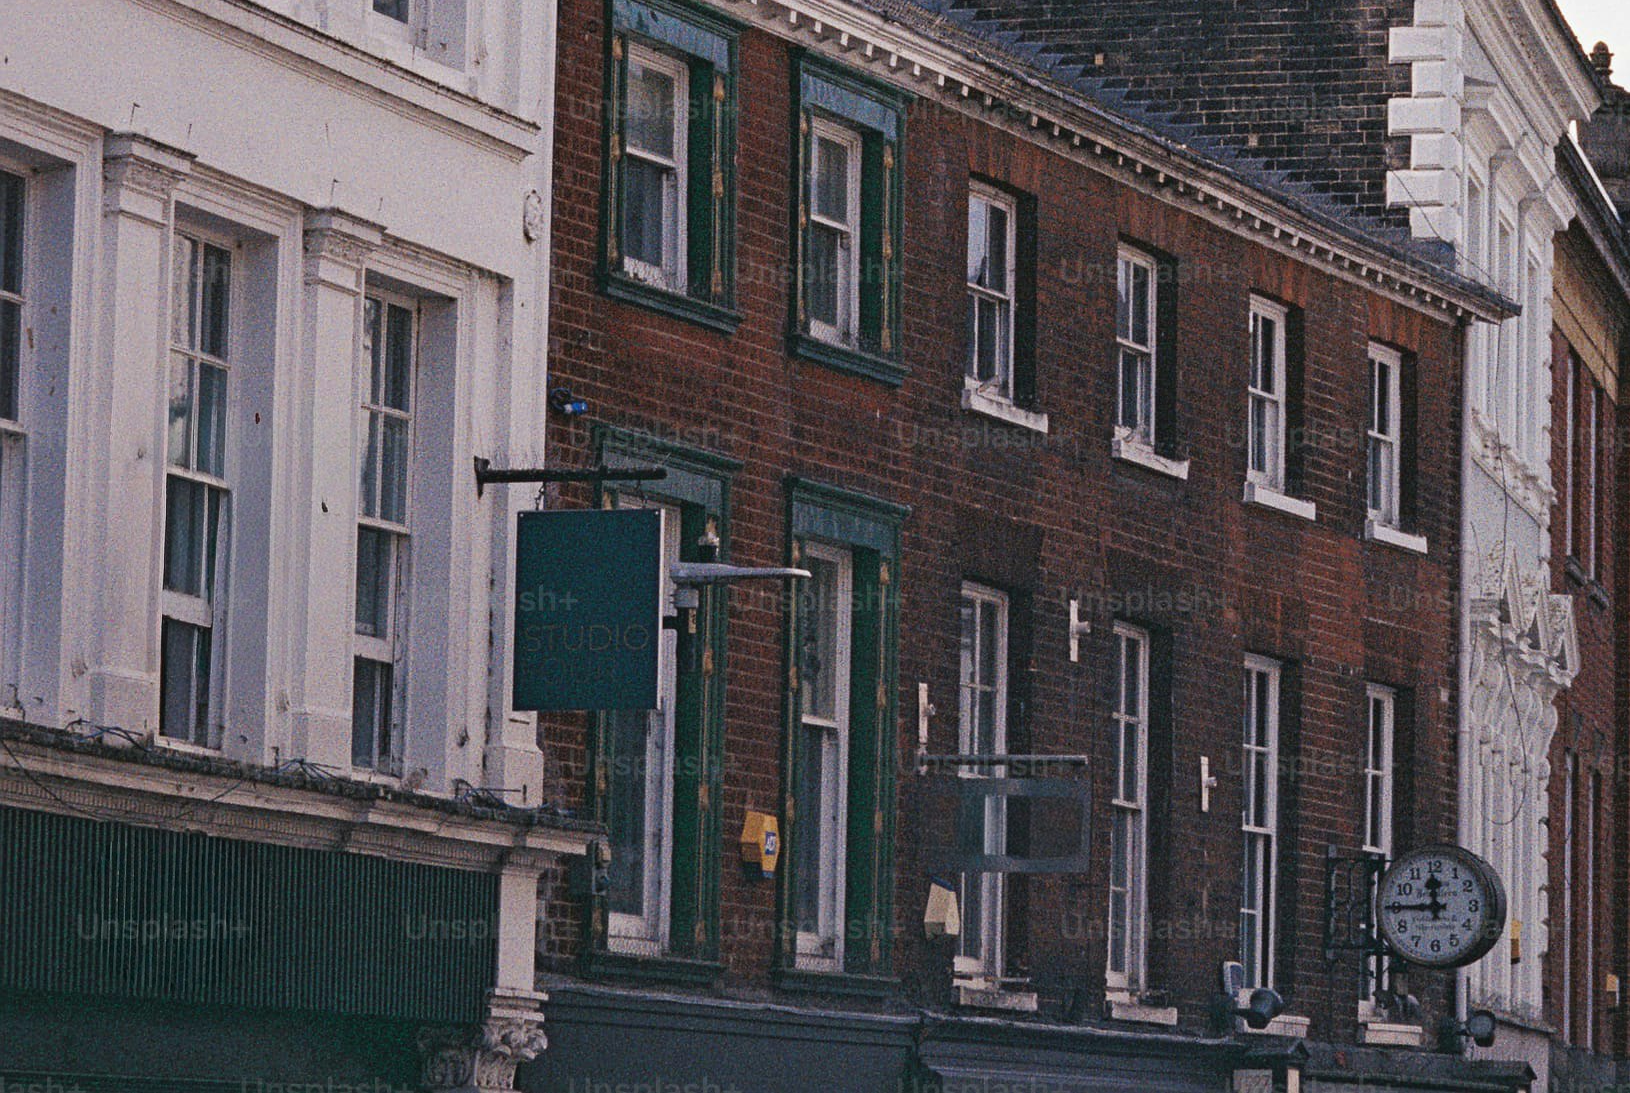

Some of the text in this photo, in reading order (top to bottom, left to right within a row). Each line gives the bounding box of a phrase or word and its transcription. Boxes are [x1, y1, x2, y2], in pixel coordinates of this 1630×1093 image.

[524, 623, 650, 653] STUDIO
[1428, 861, 1442, 873] 12
[1409, 868, 1421, 880] 11
[1452, 868, 1459, 879] 1
[1397, 883, 1412, 896] 10
[1462, 880, 1473, 892] 2
[1392, 901, 1402, 914] 9
[1468, 900, 1479, 912] 3
[1398, 920, 1407, 933] 8
[1462, 919, 1472, 931] 4
[1411, 935, 1422, 947] 7
[1431, 939, 1441, 952] 6
[1449, 934, 1459, 947] 5
